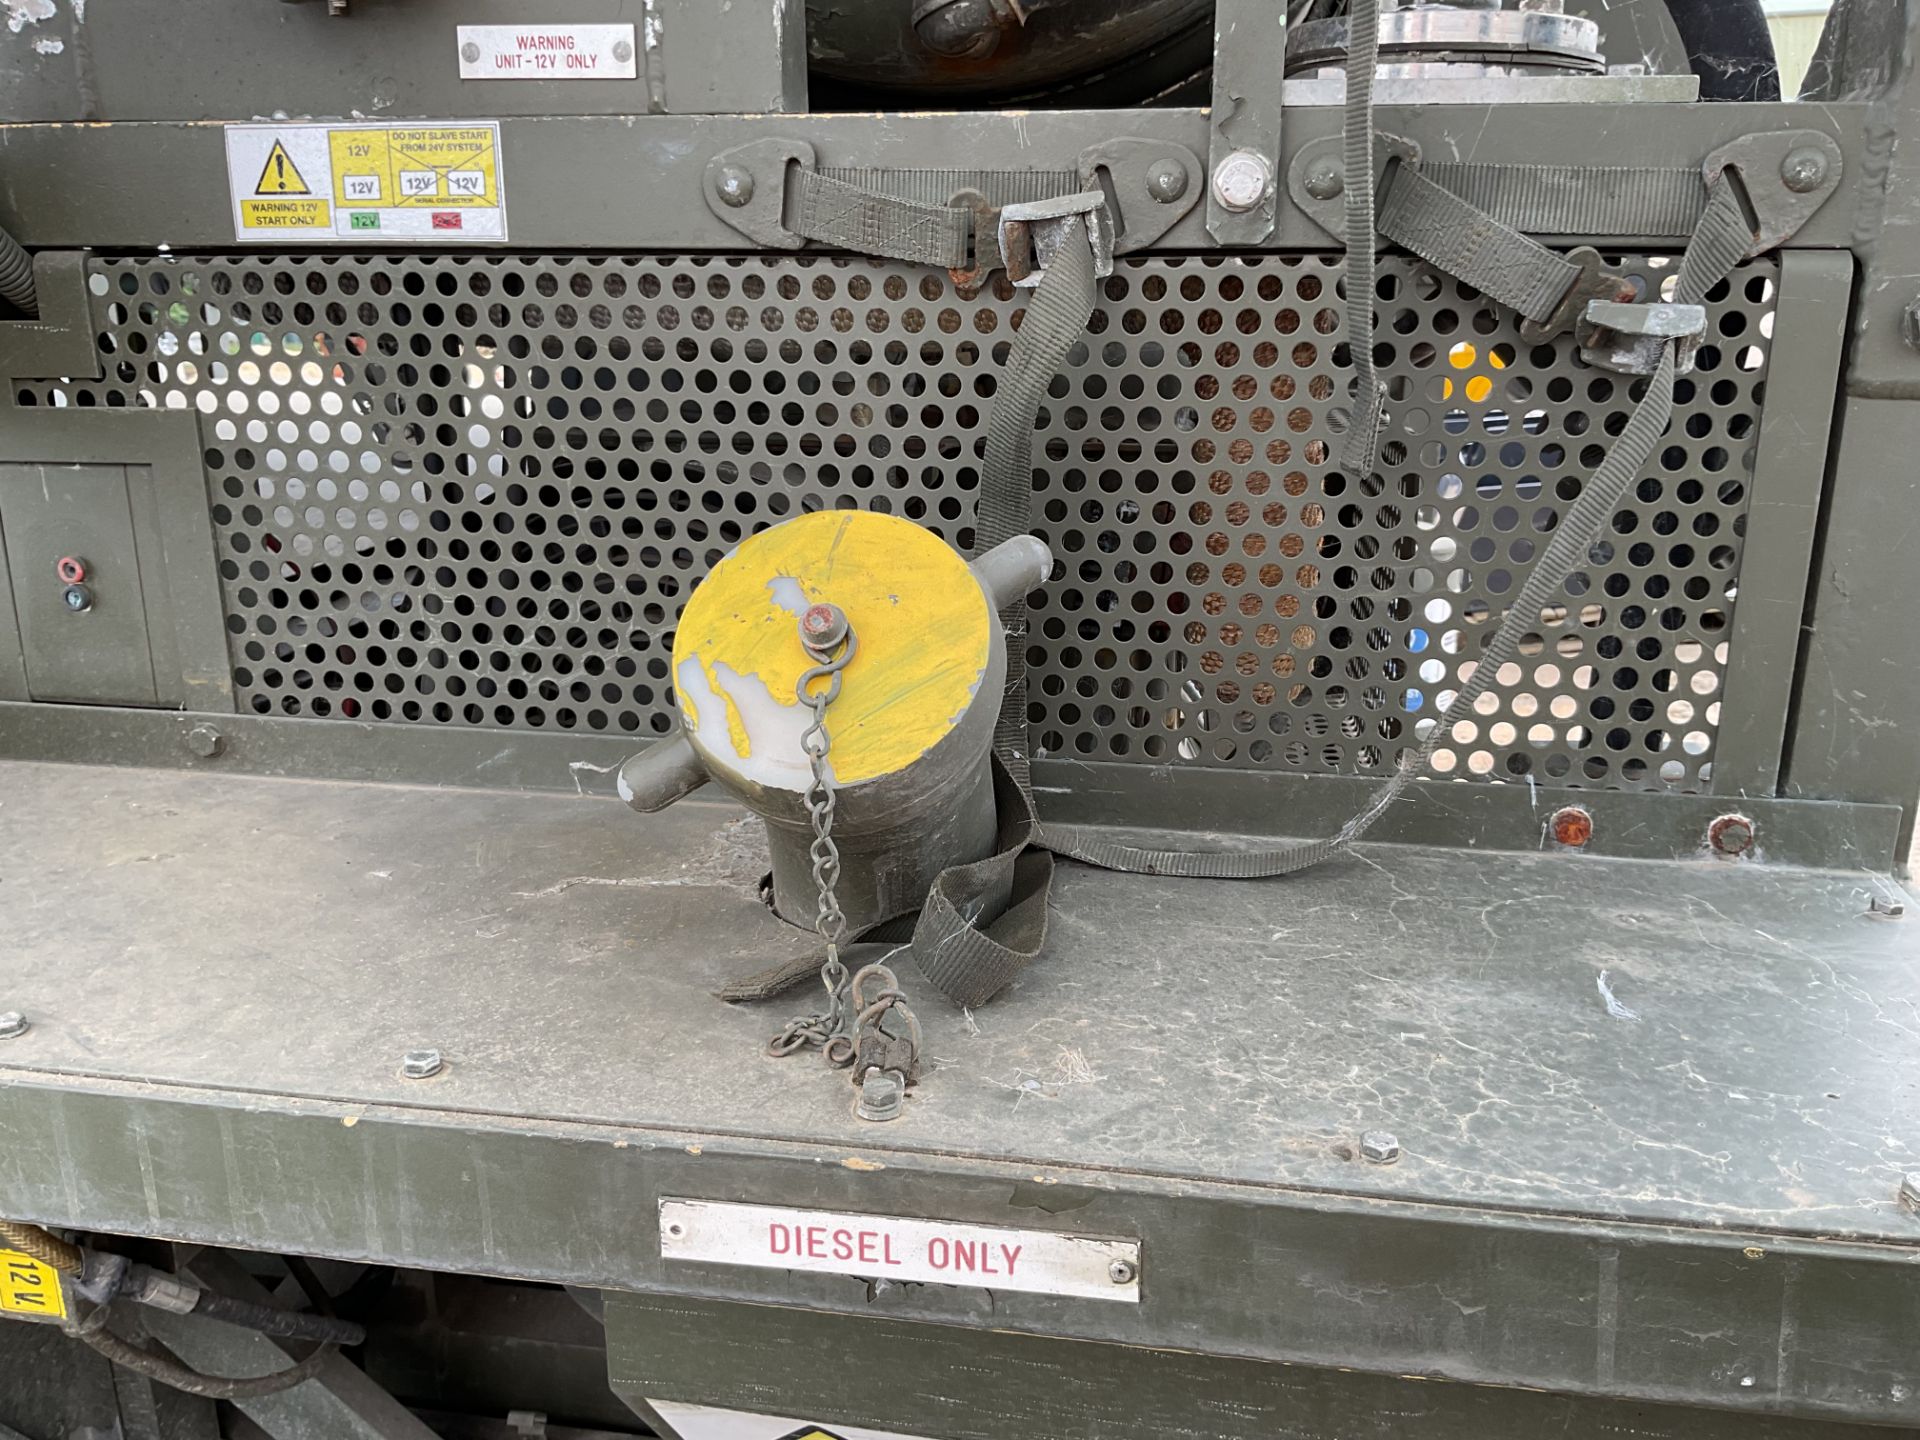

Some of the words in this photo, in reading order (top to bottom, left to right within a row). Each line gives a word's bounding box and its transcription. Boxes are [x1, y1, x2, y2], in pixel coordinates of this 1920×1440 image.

[516, 35, 575, 50] WARNING
[566, 54, 598, 69] ONLY
[392, 131, 406, 140] DO
[408, 131, 428, 140] NOT
[429, 131, 458, 140] SLAVE
[459, 130, 488, 140] START
[347, 145, 371, 157] 12V
[400, 143, 426, 152] FROM
[428, 143, 444, 152] 24V
[446, 142, 483, 152] SYSTEM
[350, 181, 374, 194] 12V
[406, 177, 431, 190] 12V
[454, 177, 479, 190] 12V
[251, 203, 298, 212] WARNING
[301, 203, 318, 212] 12V
[256, 216, 288, 226] START
[290, 216, 316, 225] ONLY
[354, 215, 377, 227] 12V
[769, 1222, 902, 1265] DIESEL
[927, 1236, 1023, 1276] ONLY
